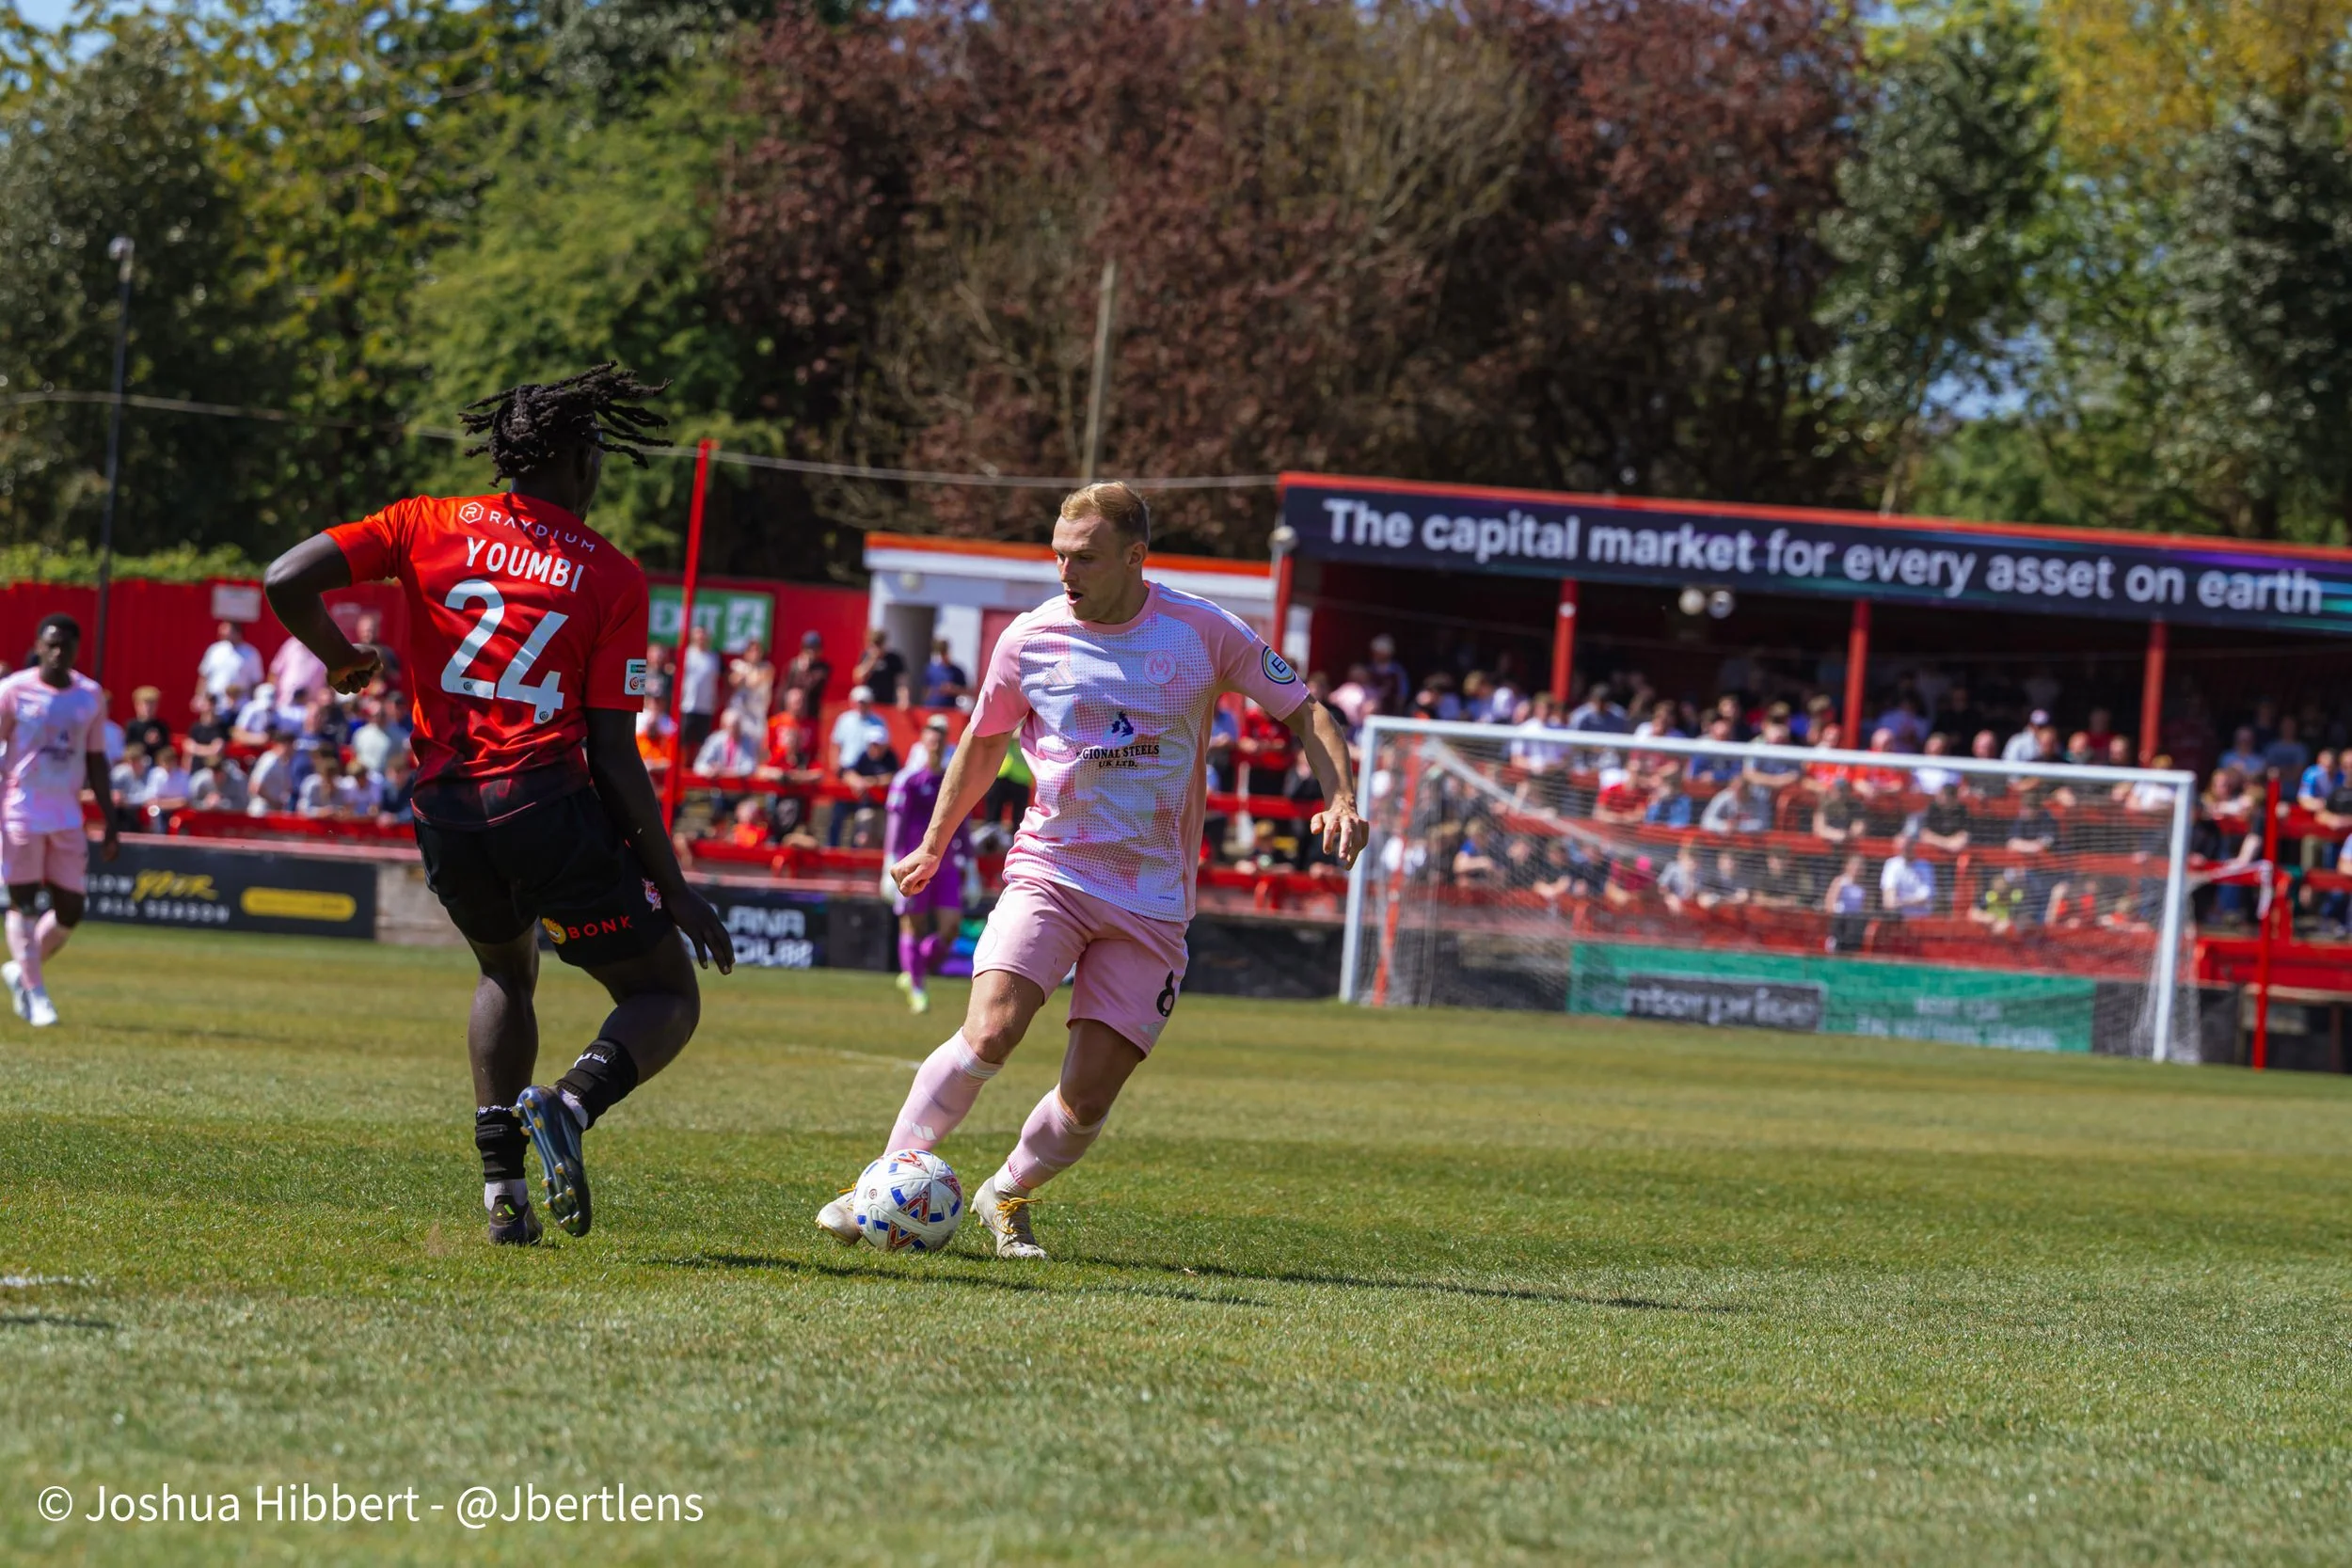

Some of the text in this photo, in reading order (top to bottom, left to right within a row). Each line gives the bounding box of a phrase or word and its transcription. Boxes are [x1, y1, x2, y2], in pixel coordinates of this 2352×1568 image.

[488, 510, 596, 553] RAYDIUM
[1323, 498, 2323, 614] The capital market for every asset on earth
[466, 536, 584, 593] YOUMBI
[441, 578, 569, 724] 24
[1122, 744, 1160, 757] STEELS
[566, 915, 634, 939] BONK
